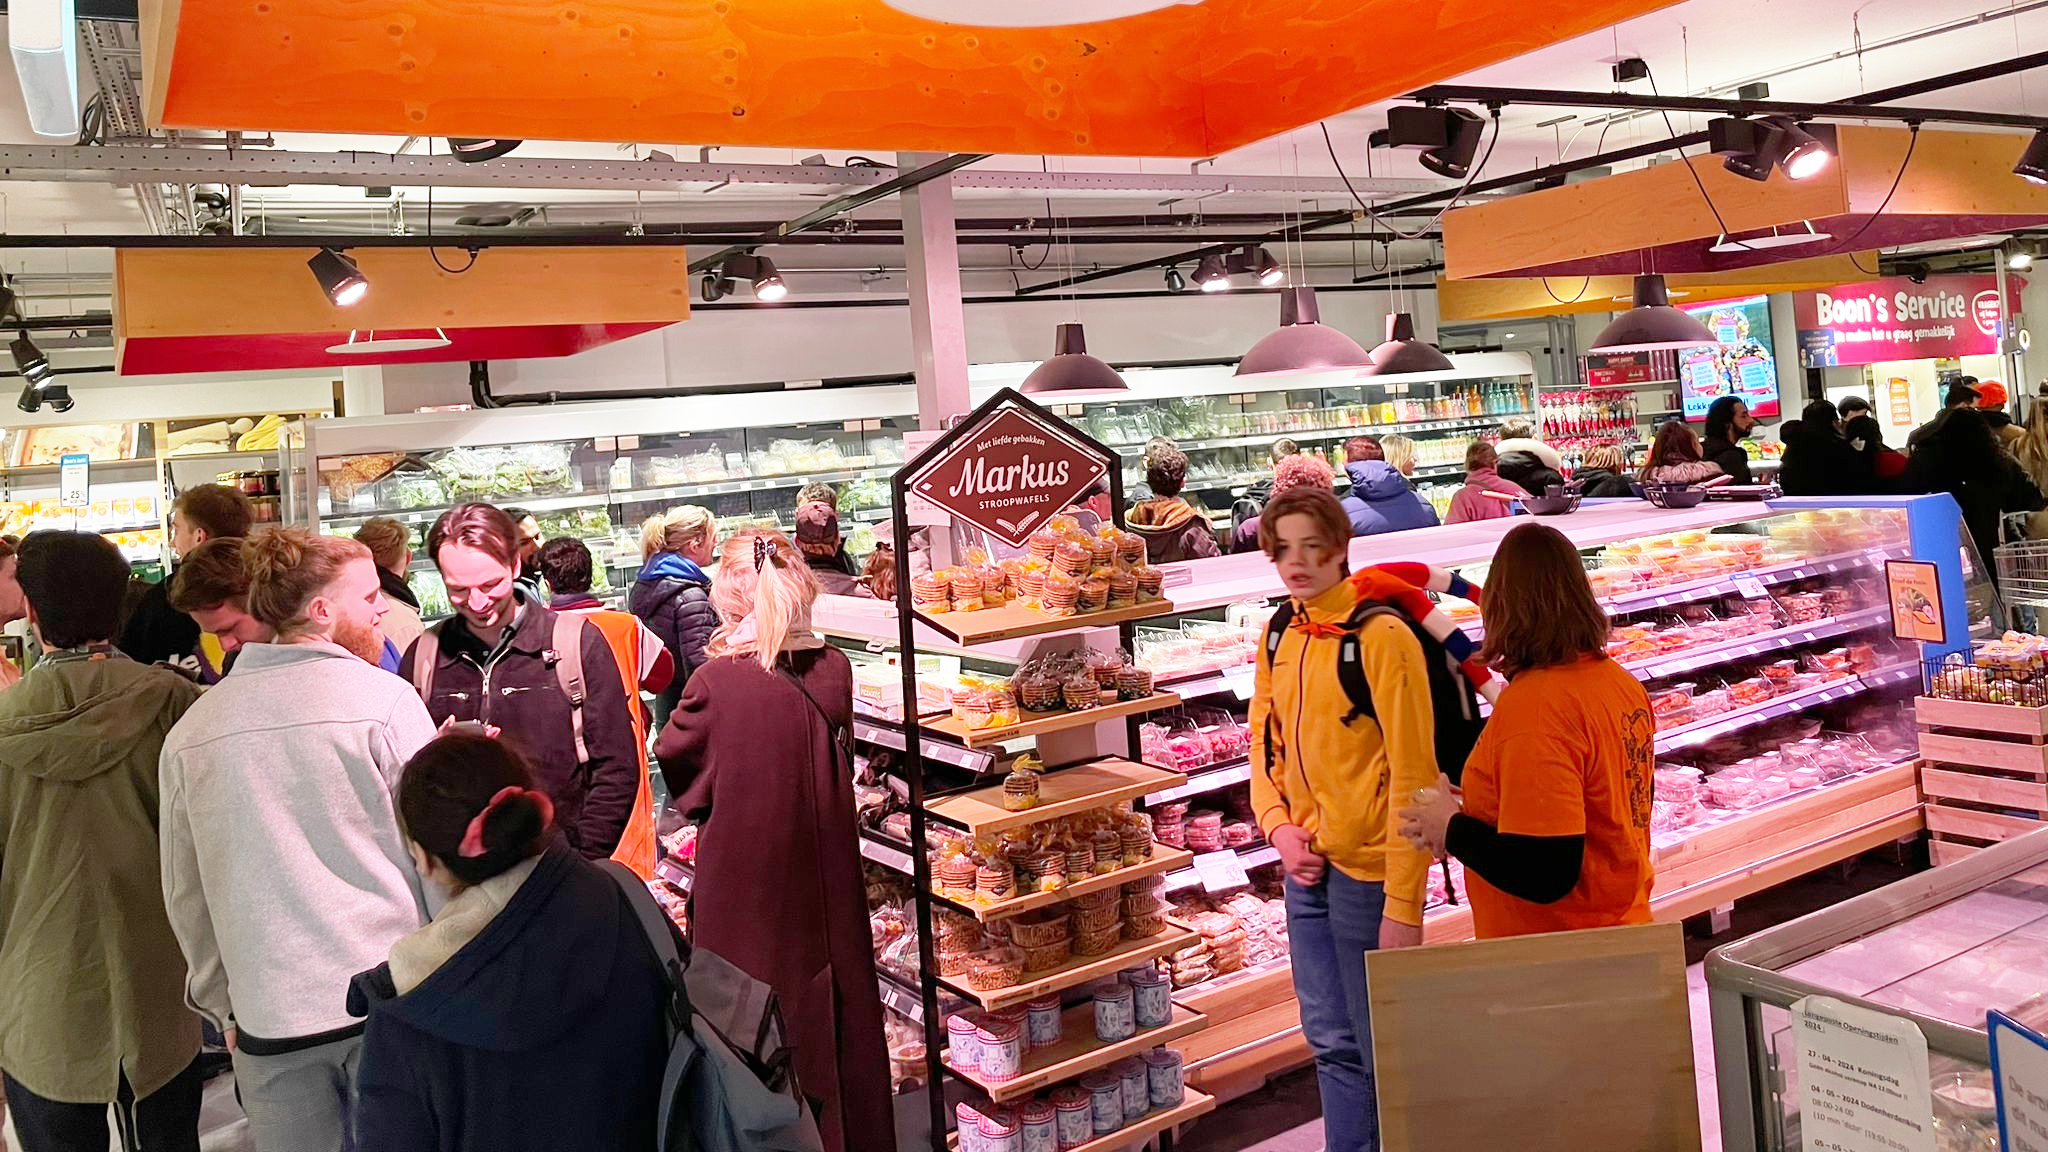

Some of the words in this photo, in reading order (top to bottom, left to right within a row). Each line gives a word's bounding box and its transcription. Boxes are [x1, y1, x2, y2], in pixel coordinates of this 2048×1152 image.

[1816, 292, 1888, 326] Boon's
[1894, 290, 1966, 322] Service
[1893, 329, 1913, 343] graag
[1914, 325, 1956, 342] gemakkelijk
[976, 440, 992, 453] Met
[992, 435, 1012, 446] liefde
[1012, 434, 1046, 446] gebakken
[948, 454, 1070, 497] Markus
[979, 493, 1050, 510] STROOPWAFELS
[1838, 1059, 1854, 1071] 2024
[1857, 1066, 1900, 1088] Koningsdag
[1811, 1084, 1820, 1093] 04
[1826, 1088, 1835, 1097] 05
[1842, 1094, 1860, 1106] 2024
